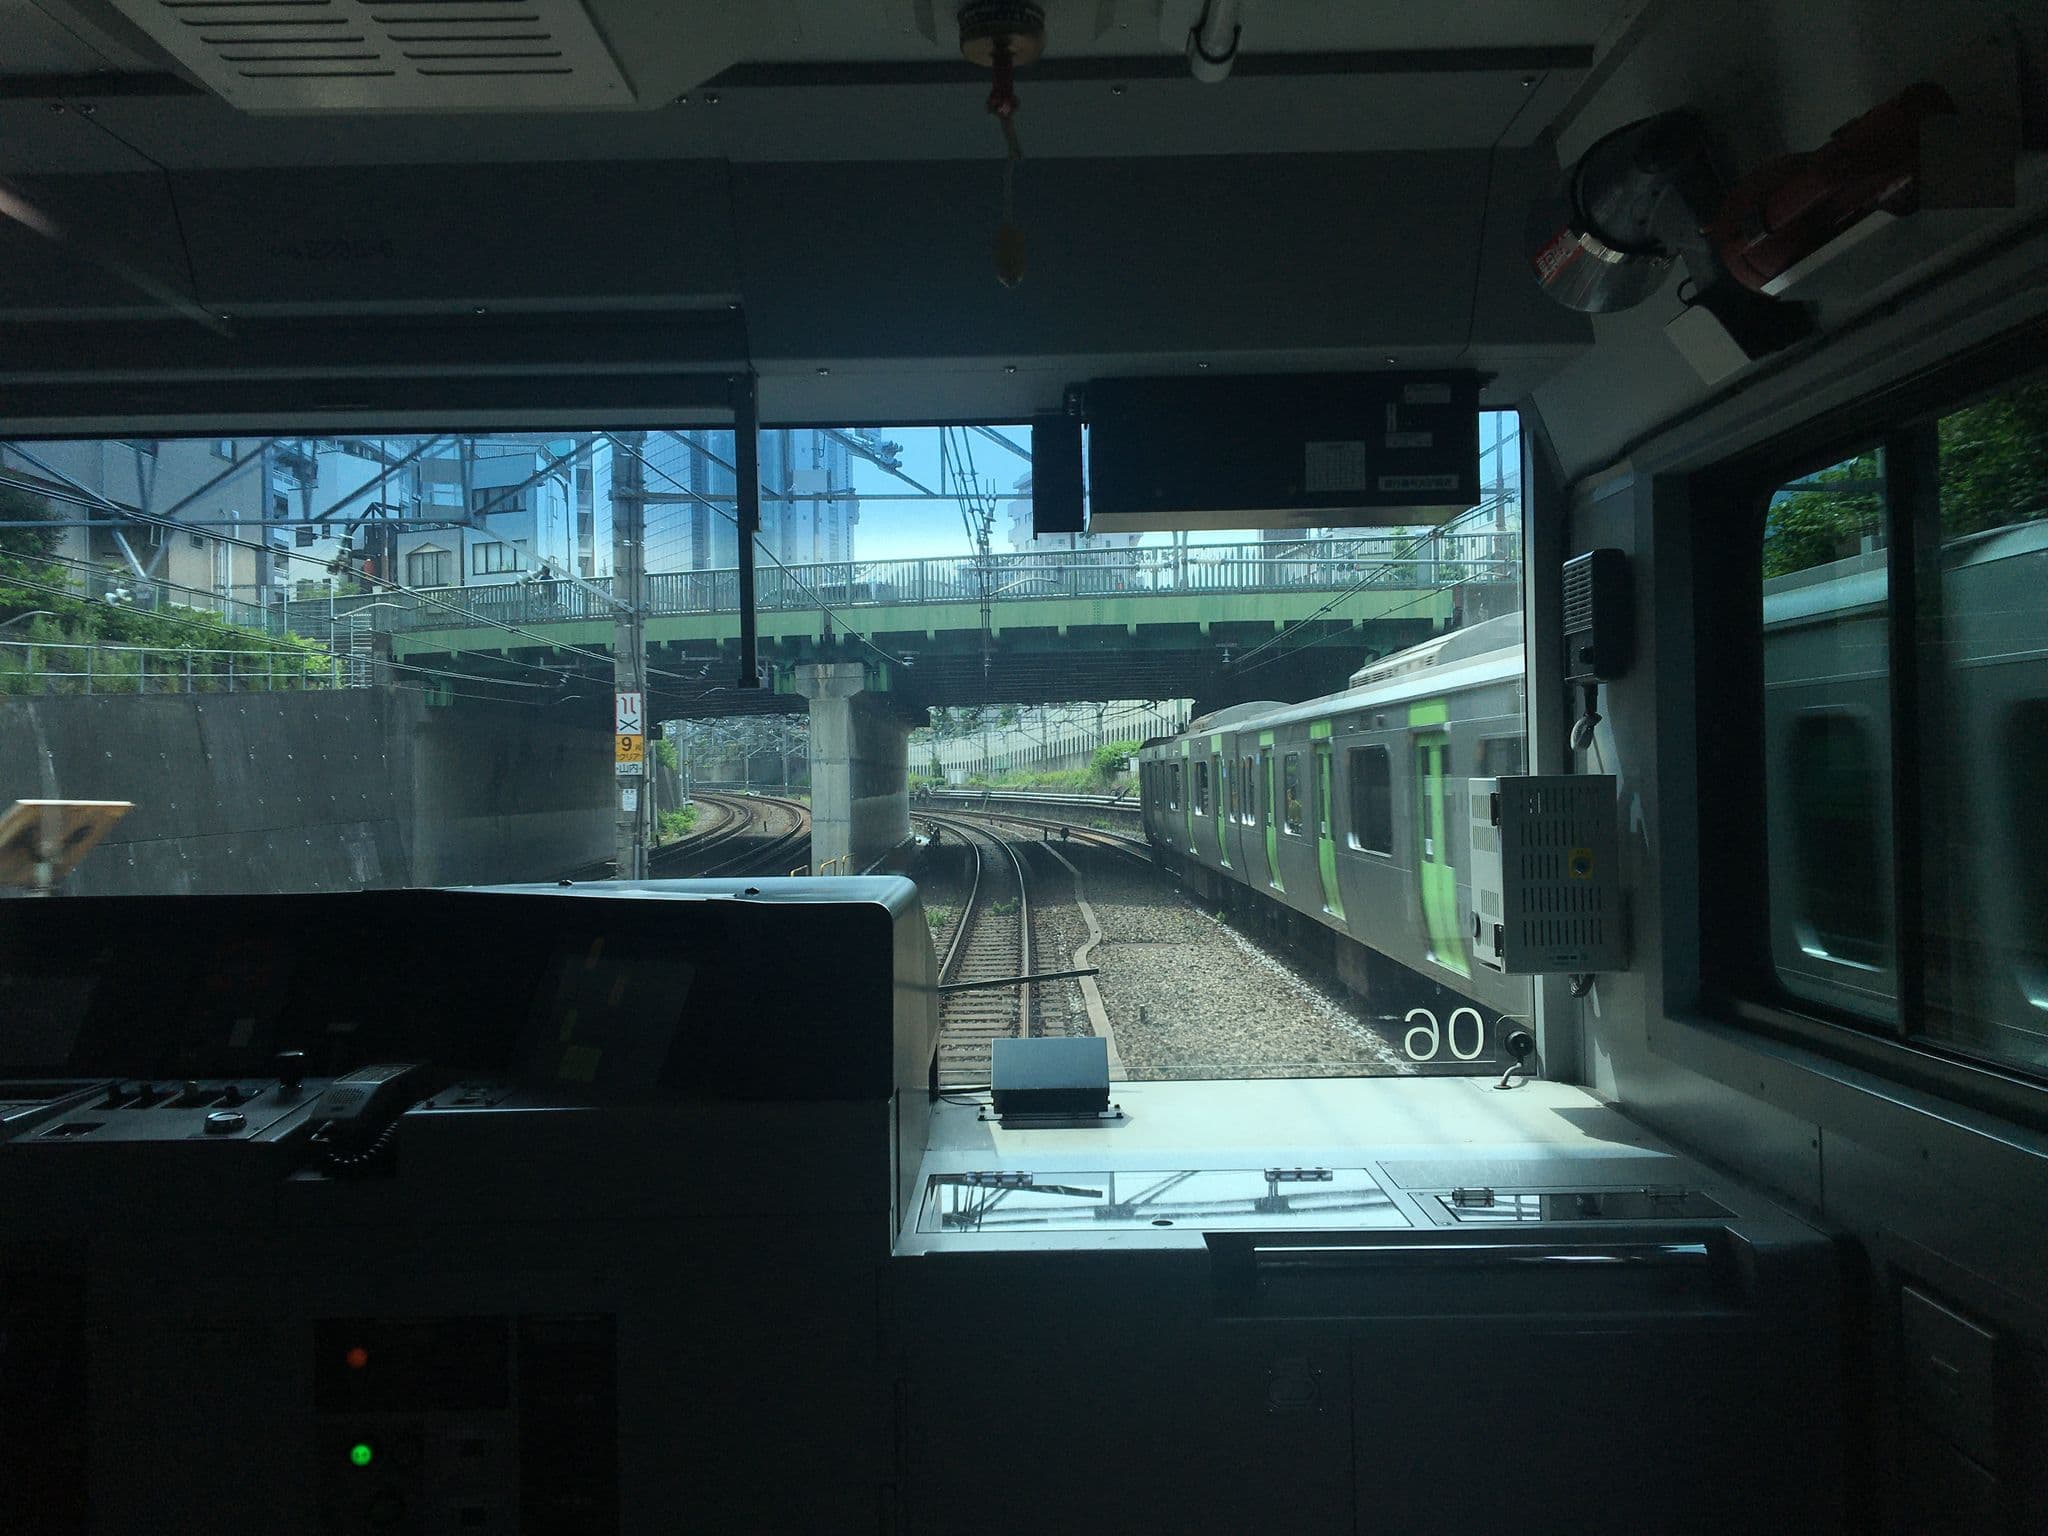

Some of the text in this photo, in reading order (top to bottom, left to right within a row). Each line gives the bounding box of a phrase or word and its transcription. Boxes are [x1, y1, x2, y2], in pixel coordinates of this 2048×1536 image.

[622, 737, 632, 752] 9
[618, 753, 641, 761] クリア
[619, 763, 639, 773] 山内
